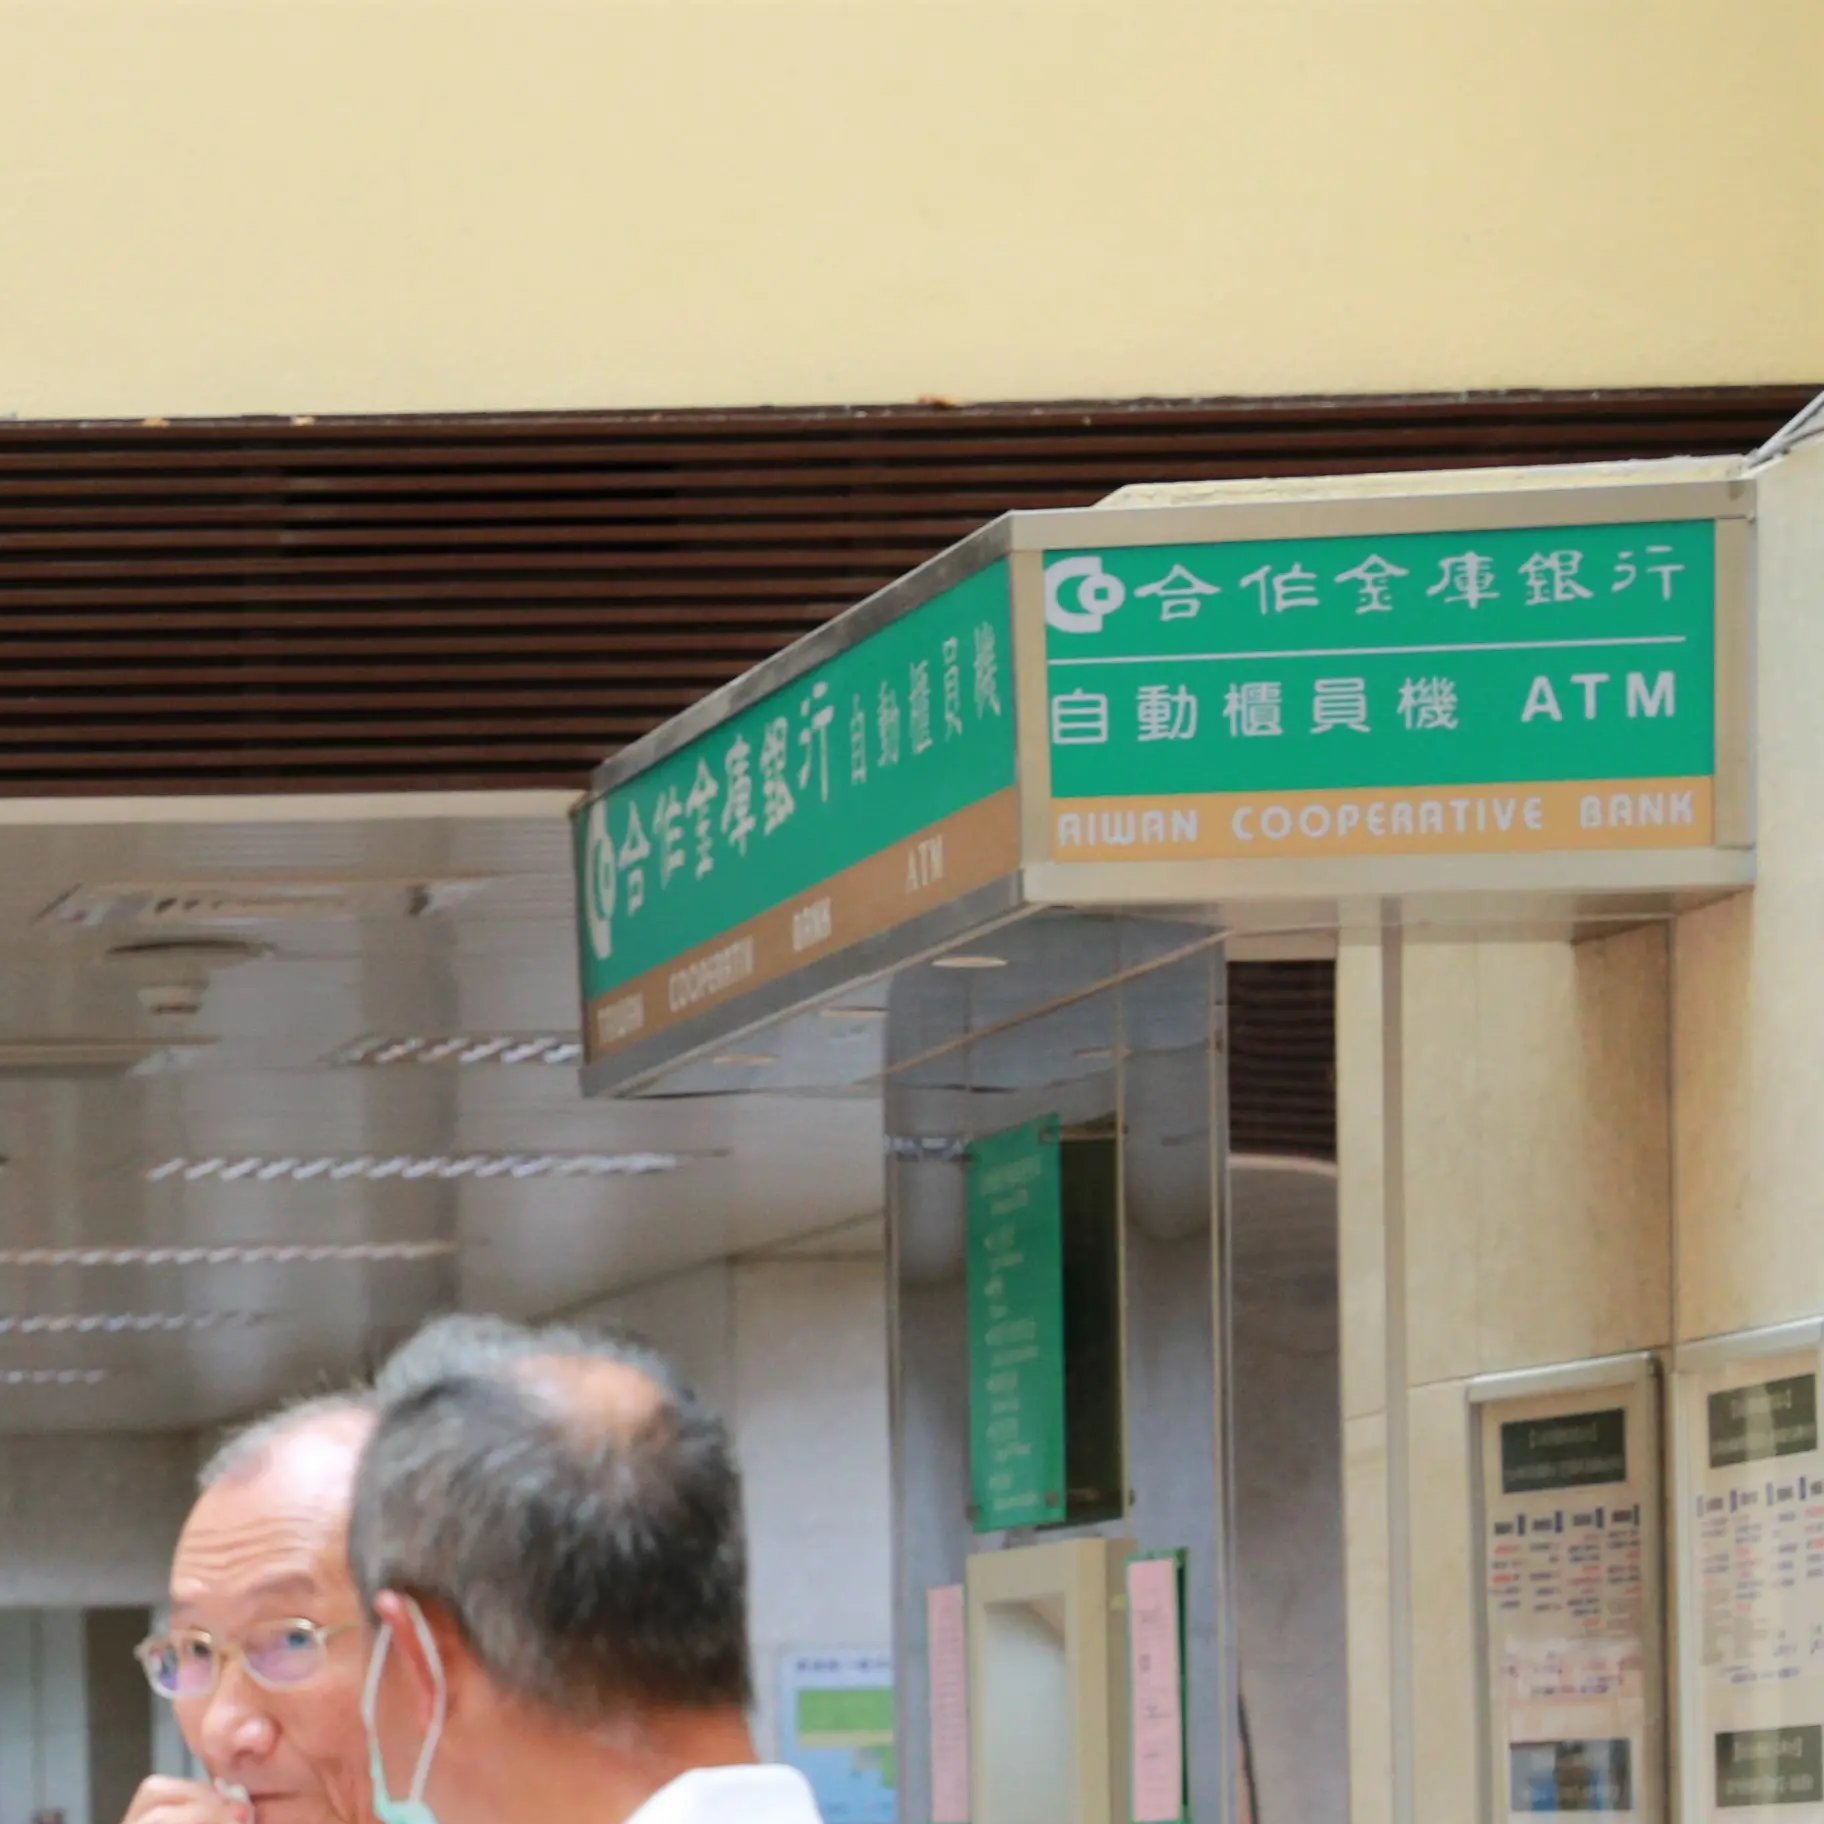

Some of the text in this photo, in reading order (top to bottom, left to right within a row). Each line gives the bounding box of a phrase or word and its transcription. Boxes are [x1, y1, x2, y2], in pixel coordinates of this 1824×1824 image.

[1133, 545, 1685, 622] 合作金庫銀行
[1051, 671, 1676, 745] 自動櫃員機 ATM
[1232, 796, 1543, 840] COOPERATIVE
[1579, 789, 1694, 829] BANK
